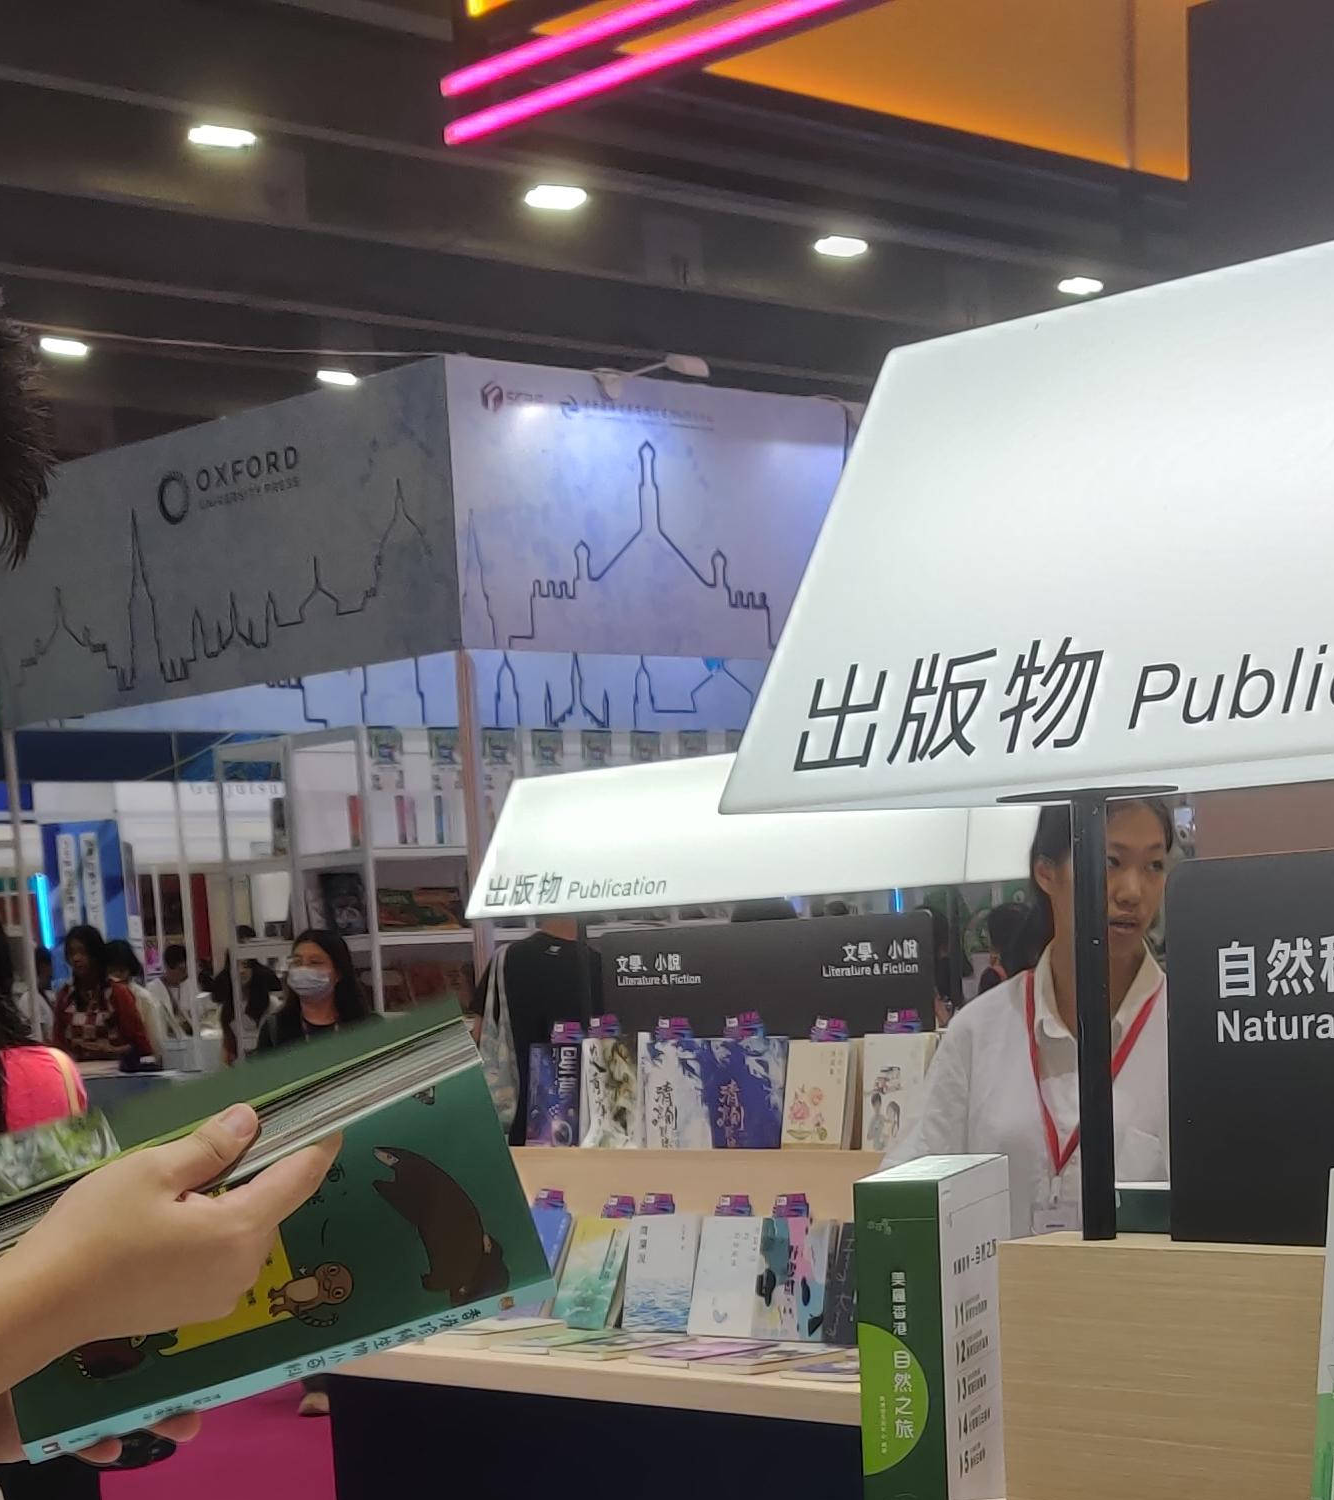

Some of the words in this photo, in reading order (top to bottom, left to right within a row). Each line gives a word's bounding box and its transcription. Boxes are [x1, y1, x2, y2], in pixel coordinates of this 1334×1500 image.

[195, 446, 300, 492] OXFORD
[792, 635, 1105, 774] 出版物
[484, 870, 563, 908] 出版物
[568, 874, 668, 899] Publication
[616, 953, 681, 974] 文學、小說
[842, 939, 918, 962] 文學、小說
[617, 975, 660, 987] Literature
[669, 973, 701, 985] Fiction
[822, 962, 871, 977] Literature
[882, 960, 919, 975] Fiction
[892, 1350, 916, 1440] 自然之旅
